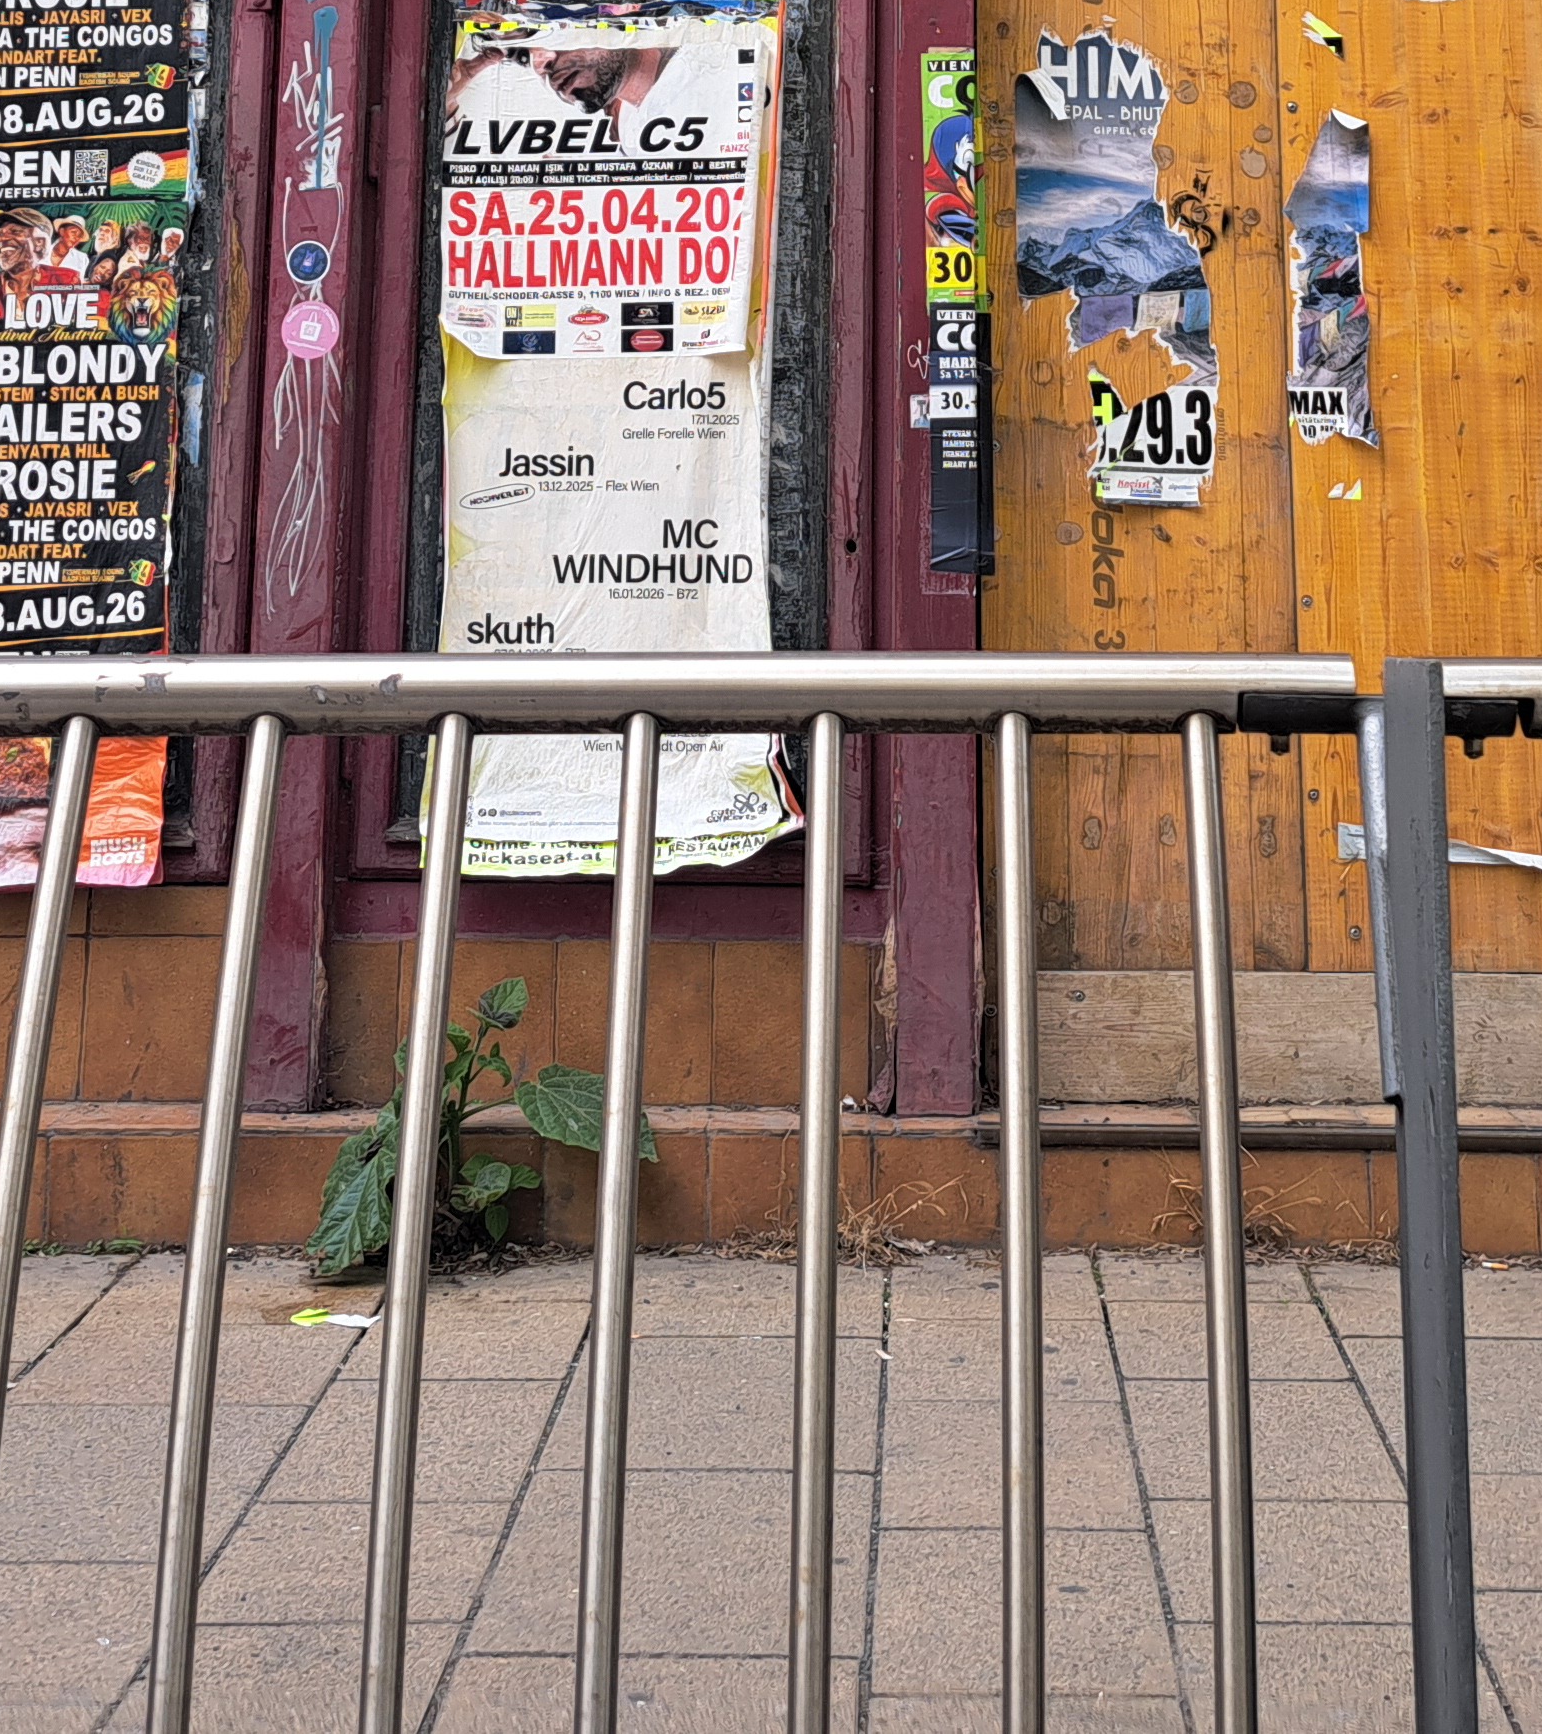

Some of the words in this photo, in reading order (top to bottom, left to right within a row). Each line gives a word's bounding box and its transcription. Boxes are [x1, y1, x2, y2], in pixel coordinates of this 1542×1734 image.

[39, 10, 105, 26] JAYASRI
[121, 9, 151, 24] VEX
[26, 27, 69, 48] THE
[76, 25, 173, 47] CONGOS
[13, 66, 76, 88] PENN
[623, 380, 726, 411] Carlo5
[622, 428, 654, 441] Grelle
[658, 427, 691, 440] Forelle
[694, 427, 726, 440] Wien
[499, 446, 595, 478] Jassin
[662, 518, 719, 549] MC
[553, 553, 753, 585] WINDHUND
[467, 613, 555, 646] skuth
